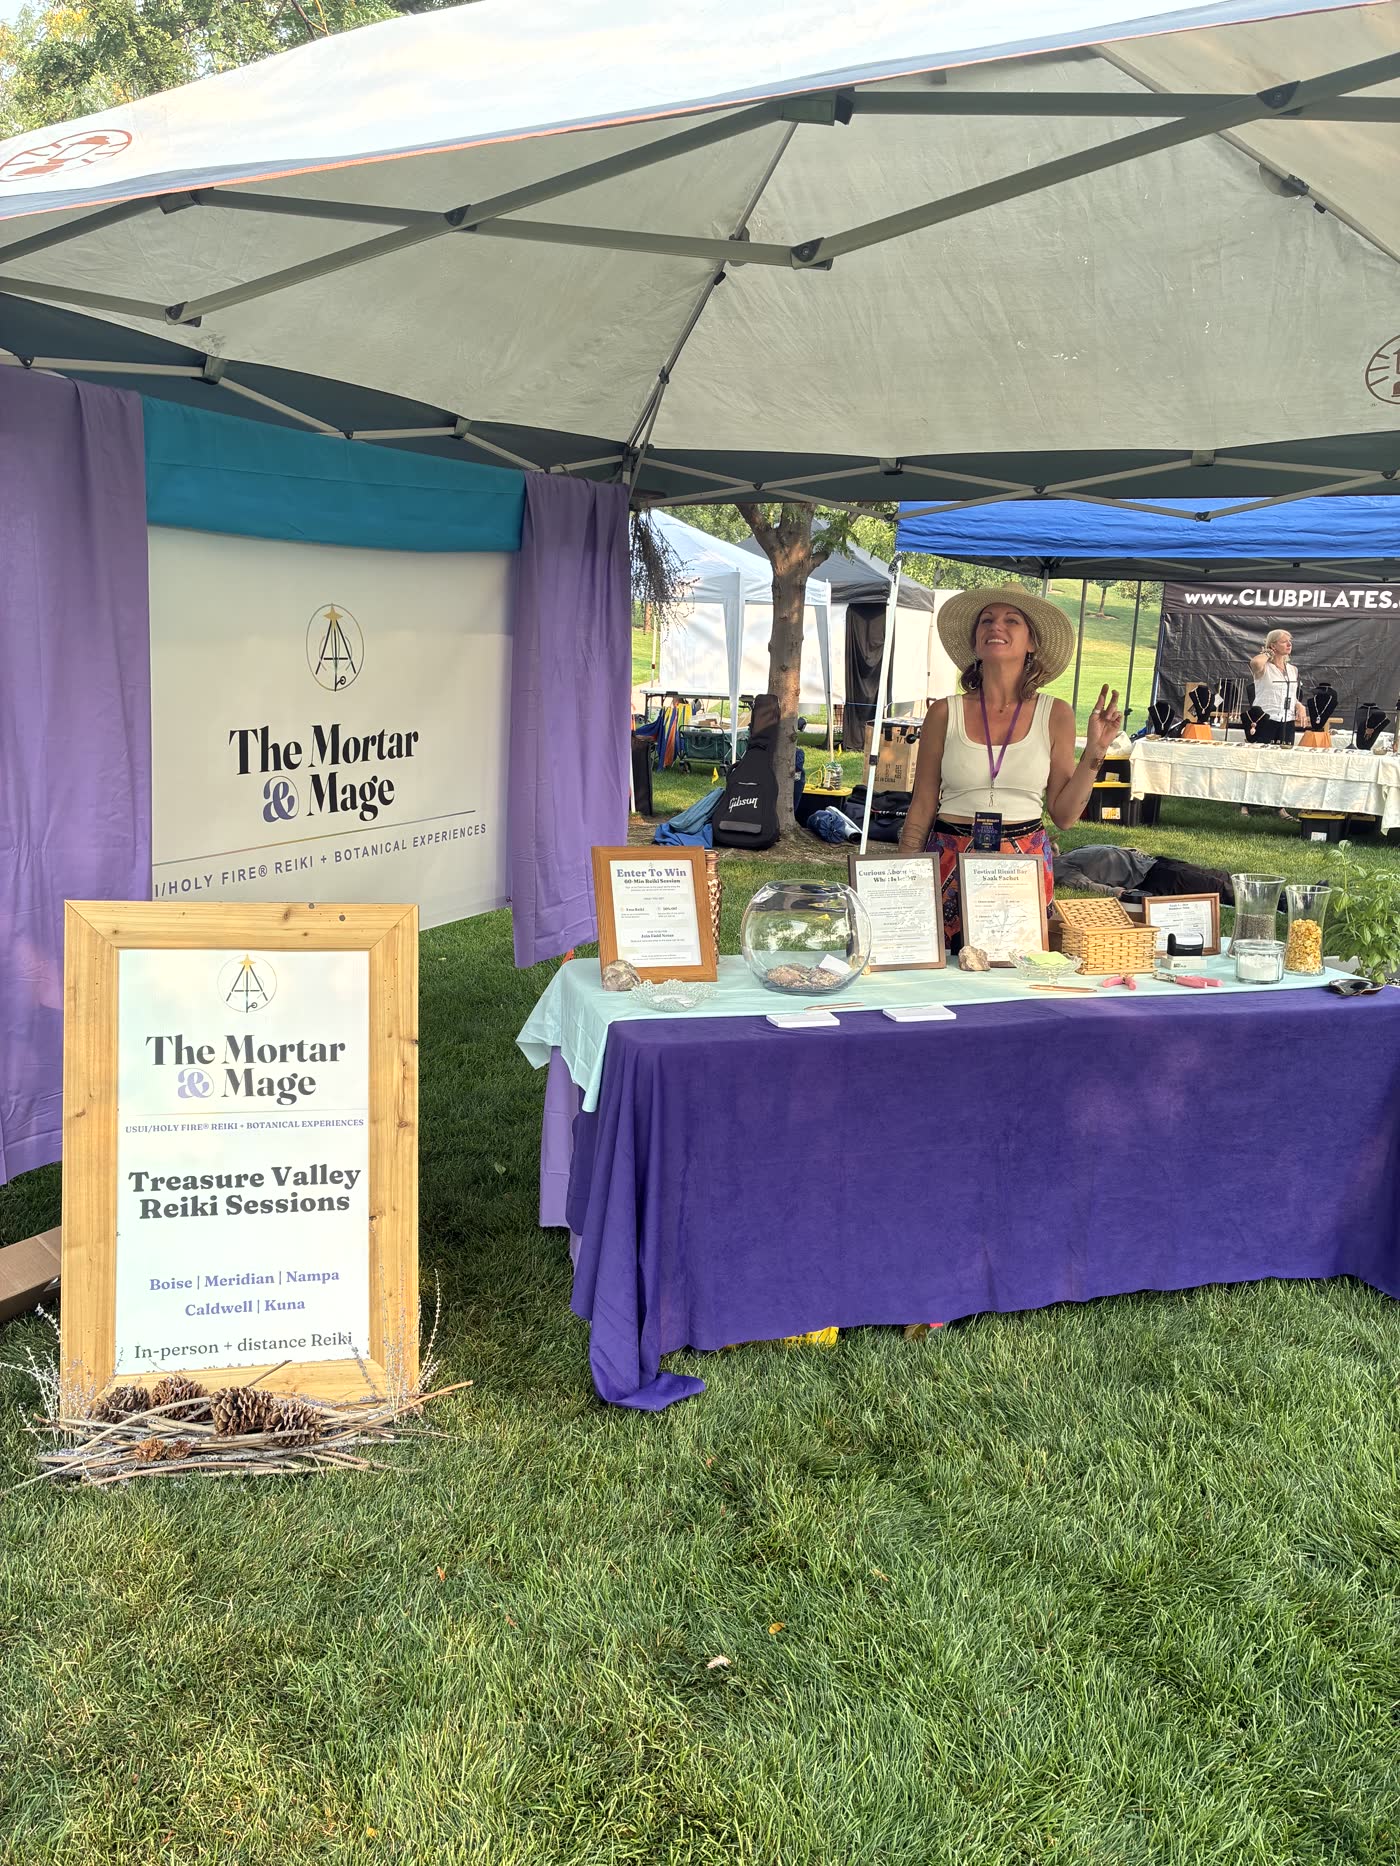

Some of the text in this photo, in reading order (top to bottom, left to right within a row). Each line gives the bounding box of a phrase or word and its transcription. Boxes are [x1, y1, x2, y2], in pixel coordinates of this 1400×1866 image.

[1185, 589, 1400, 609] www.CLUBPILATES.
[229, 723, 419, 775] The Mortar
[263, 772, 395, 823] & Mage
[729, 796, 758, 813] Gibson
[222, 864, 268, 885] FIRE®
[275, 855, 313, 874] REIKI
[320, 856, 327, 864] +
[334, 840, 407, 863] BOTANICAL
[413, 823, 487, 847] EXPERIENCES
[617, 868, 687, 878] Enter To Win
[145, 1034, 346, 1066] The Mortar
[177, 1067, 317, 1106] & Mage
[125, 1124, 179, 1134] USUI/HOLY
[181, 1123, 210, 1132] FIRE®
[211, 1122, 238, 1131] REIKI
[246, 1120, 300, 1130] BOTANICAL
[301, 1119, 364, 1128] EXPERIENCES
[128, 1163, 362, 1192] Treasure Valley
[139, 1192, 350, 1219] Reiki Sessions
[150, 1277, 193, 1291] Boise
[204, 1272, 275, 1288] Meridian
[286, 1270, 340, 1284] Nampa
[185, 1300, 253, 1316] Caldwell
[264, 1299, 306, 1312] Kuna
[134, 1332, 353, 1361] In-person + distance Reiki
